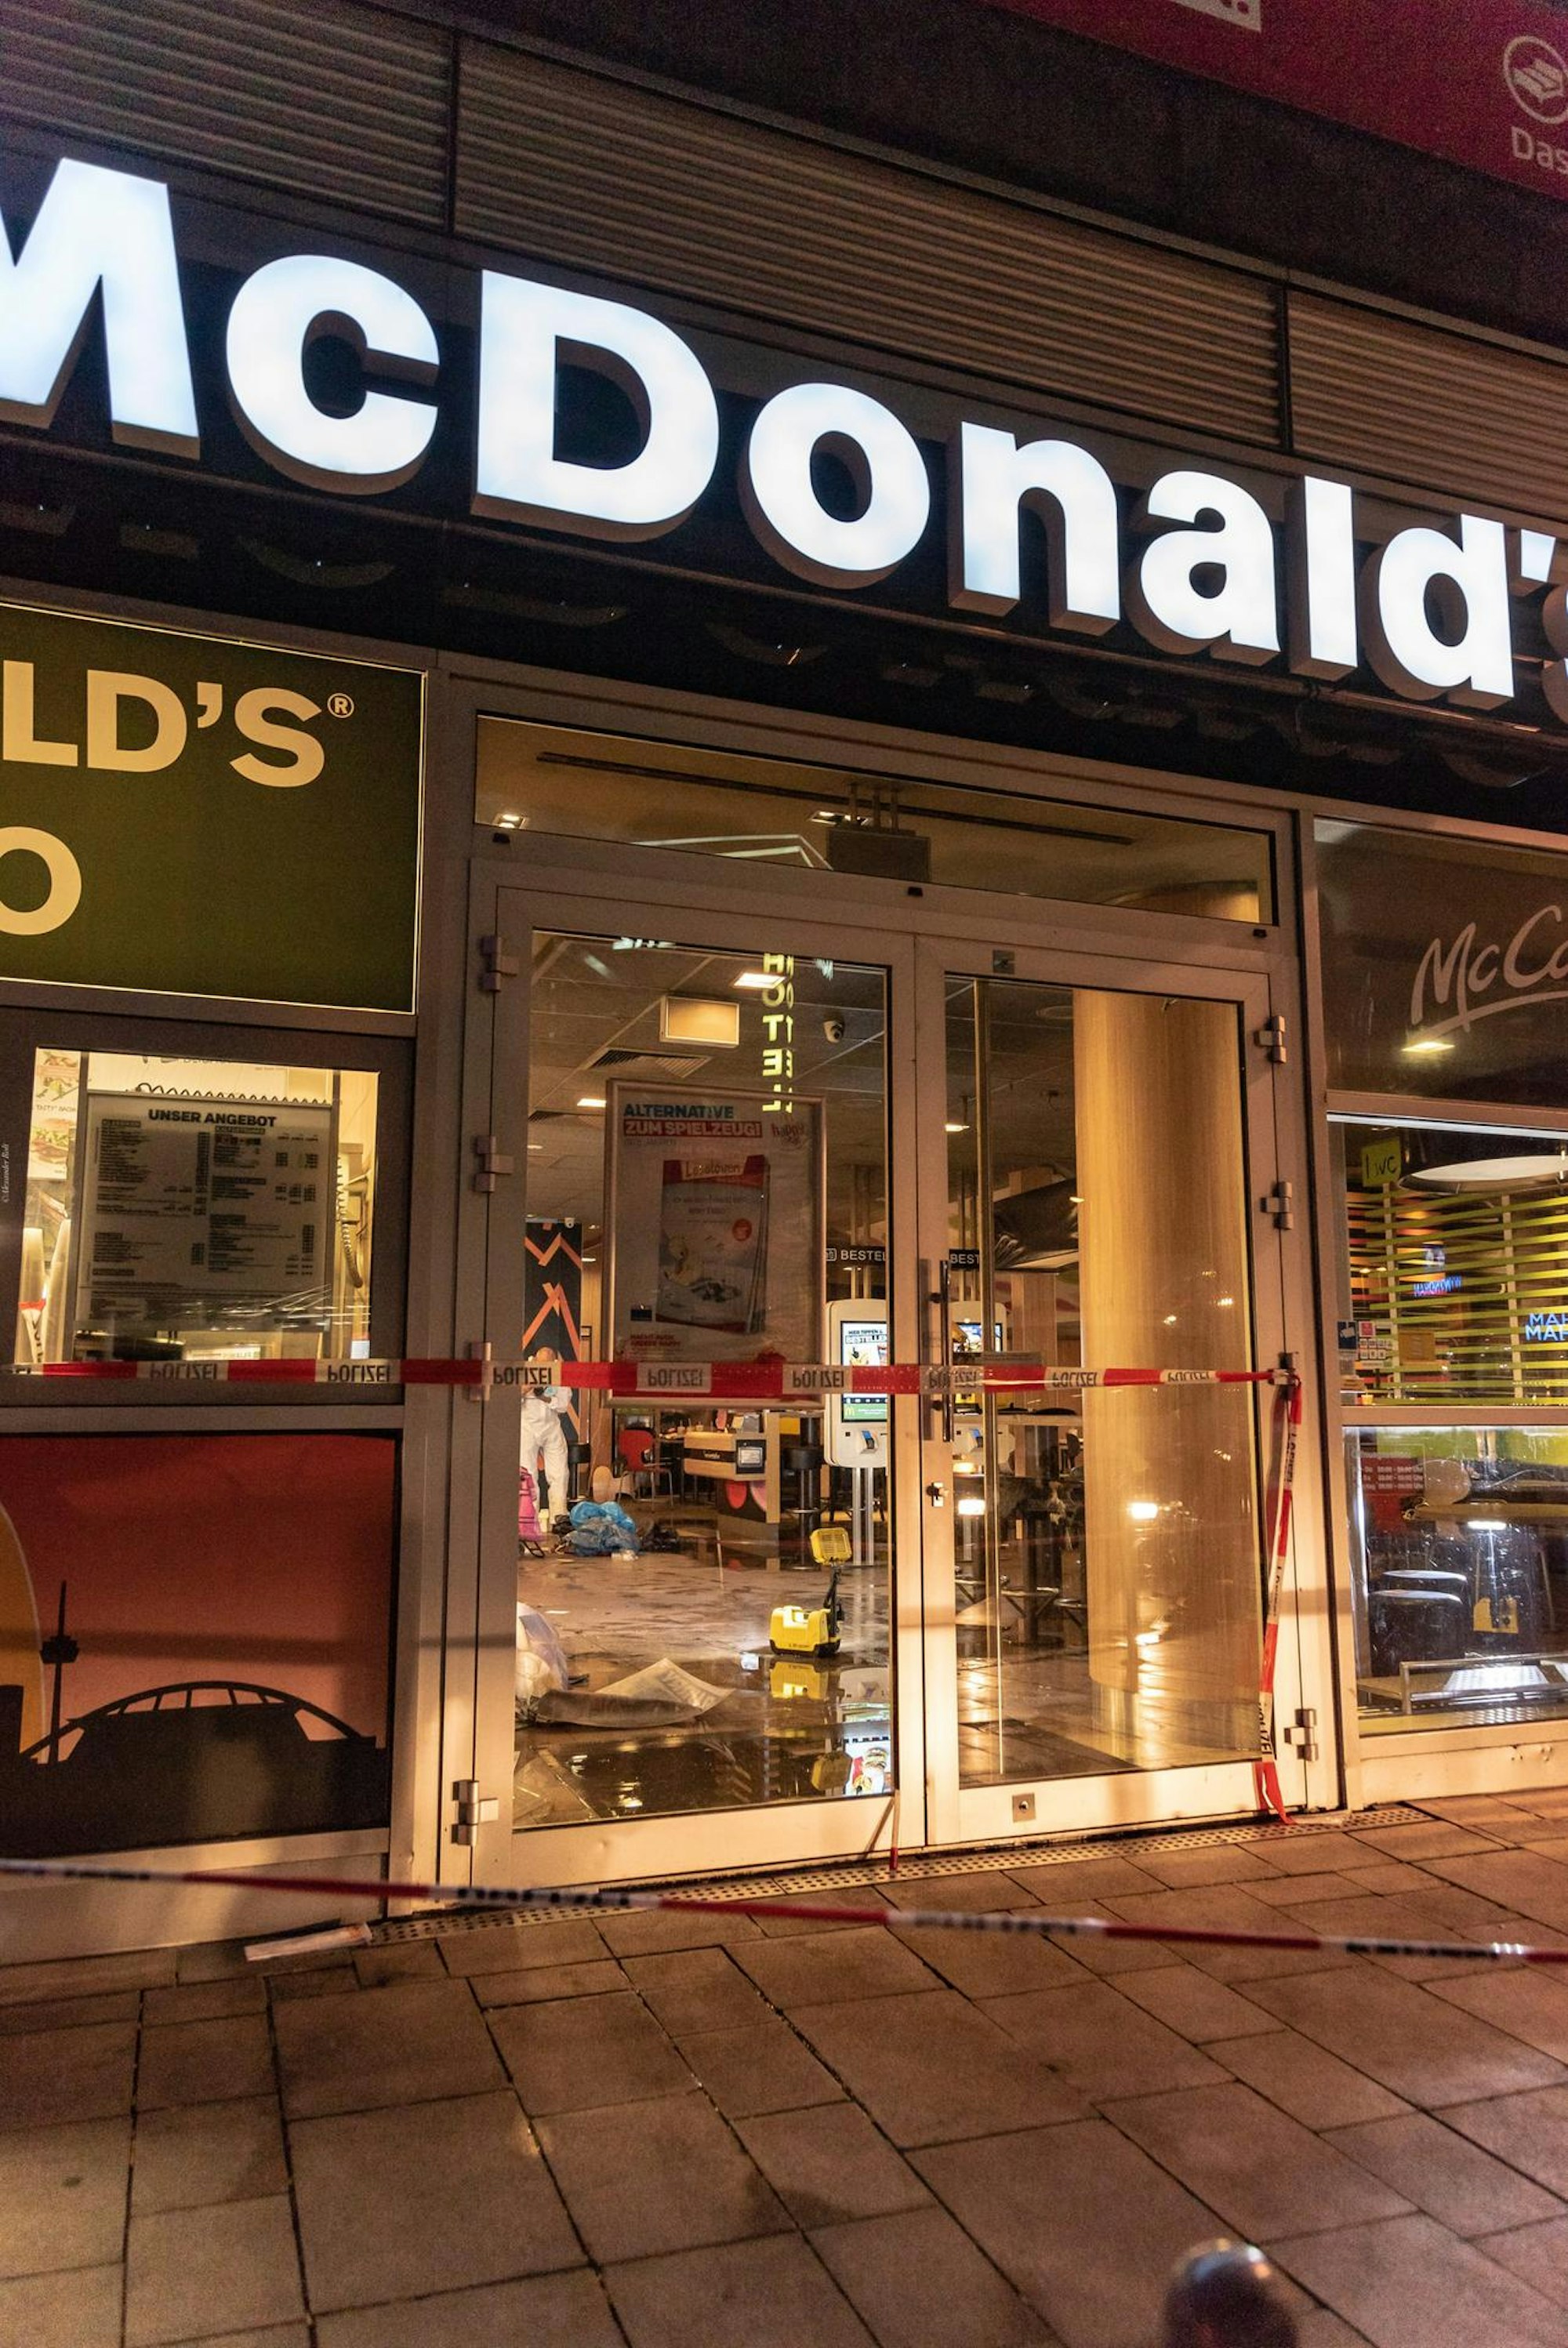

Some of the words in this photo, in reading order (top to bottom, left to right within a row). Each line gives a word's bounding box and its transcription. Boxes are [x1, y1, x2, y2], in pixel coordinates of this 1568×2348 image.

[0, 157, 1568, 706] McDonald'
[149, 1109, 201, 1123] UNSER
[204, 1113, 277, 1127] ANGEBOT
[623, 1104, 734, 1119] ALTERNATIVE
[626, 1121, 662, 1136] ZUM
[665, 1121, 761, 1137] SPIELZEUG!
